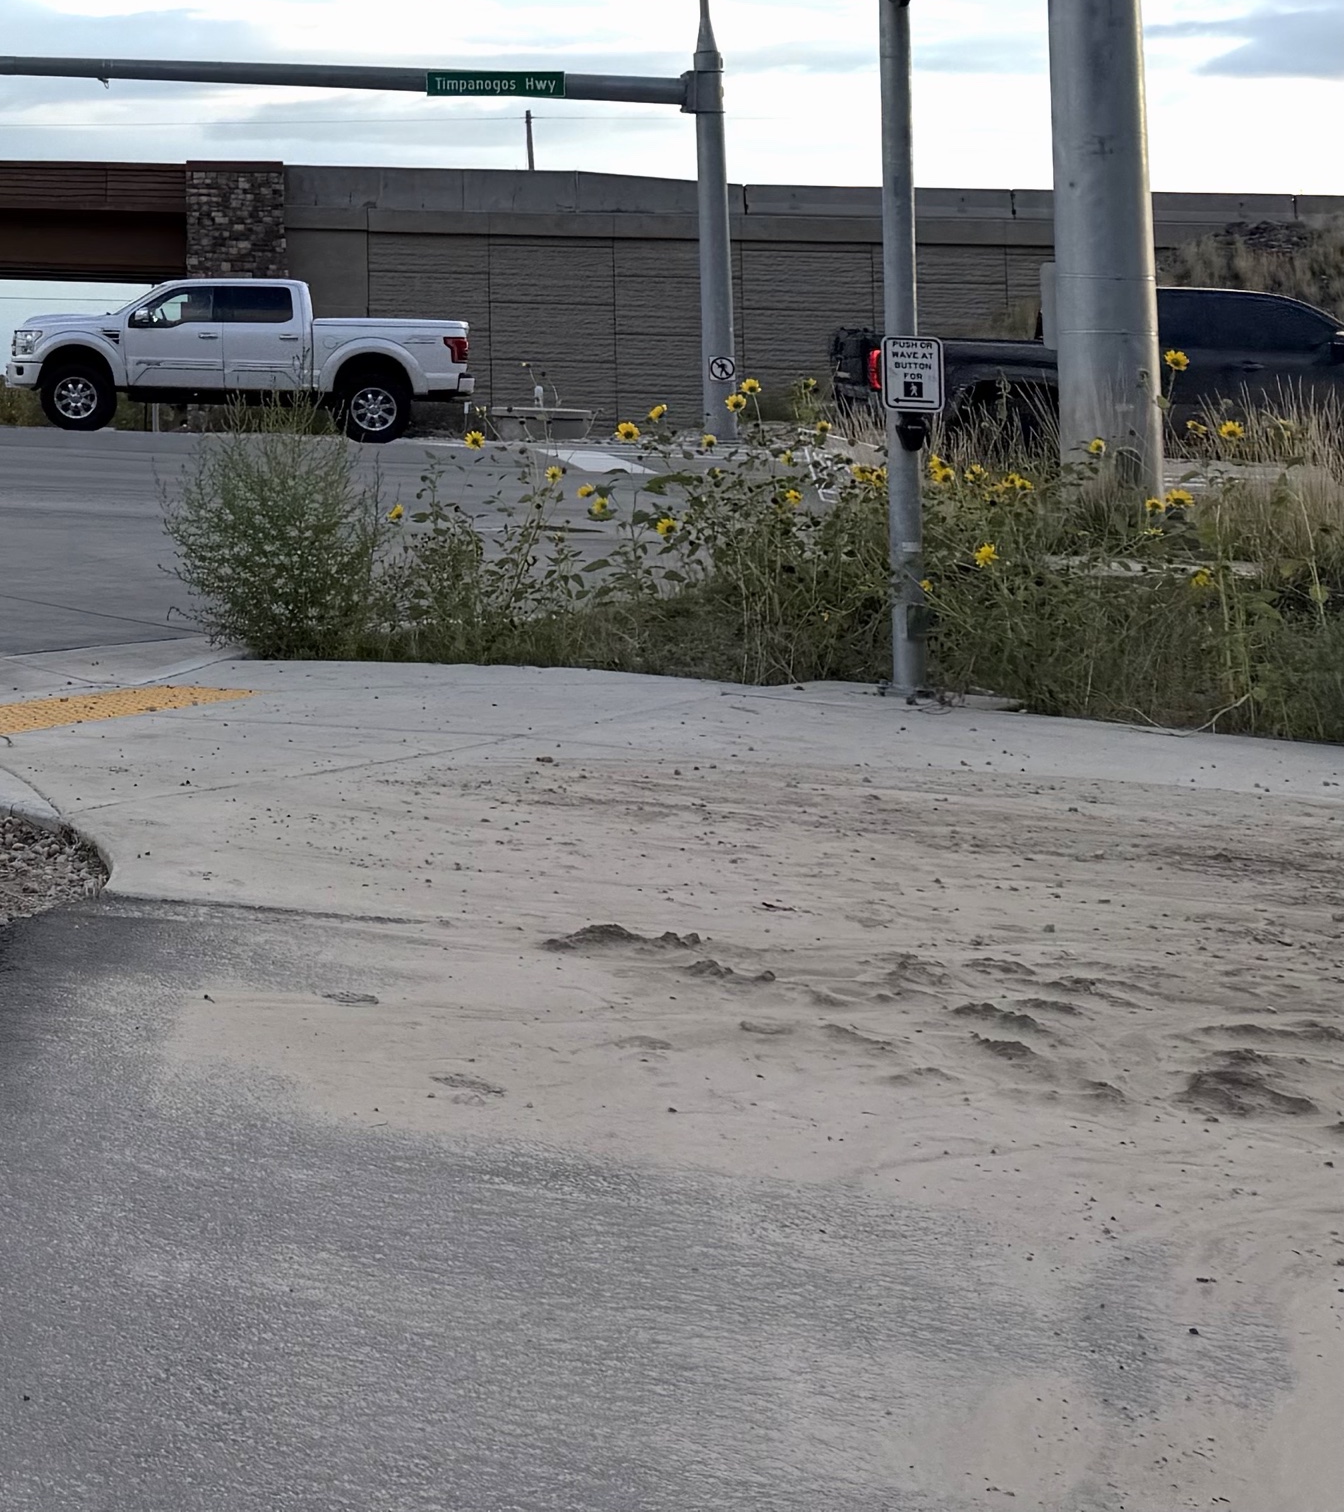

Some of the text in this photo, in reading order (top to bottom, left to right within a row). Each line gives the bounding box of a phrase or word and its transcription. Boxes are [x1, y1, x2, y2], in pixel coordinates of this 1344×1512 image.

[434, 77, 556, 94] Timpanogos Hwy
[892, 340, 933, 350] PUSH OR
[892, 351, 919, 359] WAVE
[894, 361, 932, 370] BUTTON
[903, 372, 923, 380] FOR
